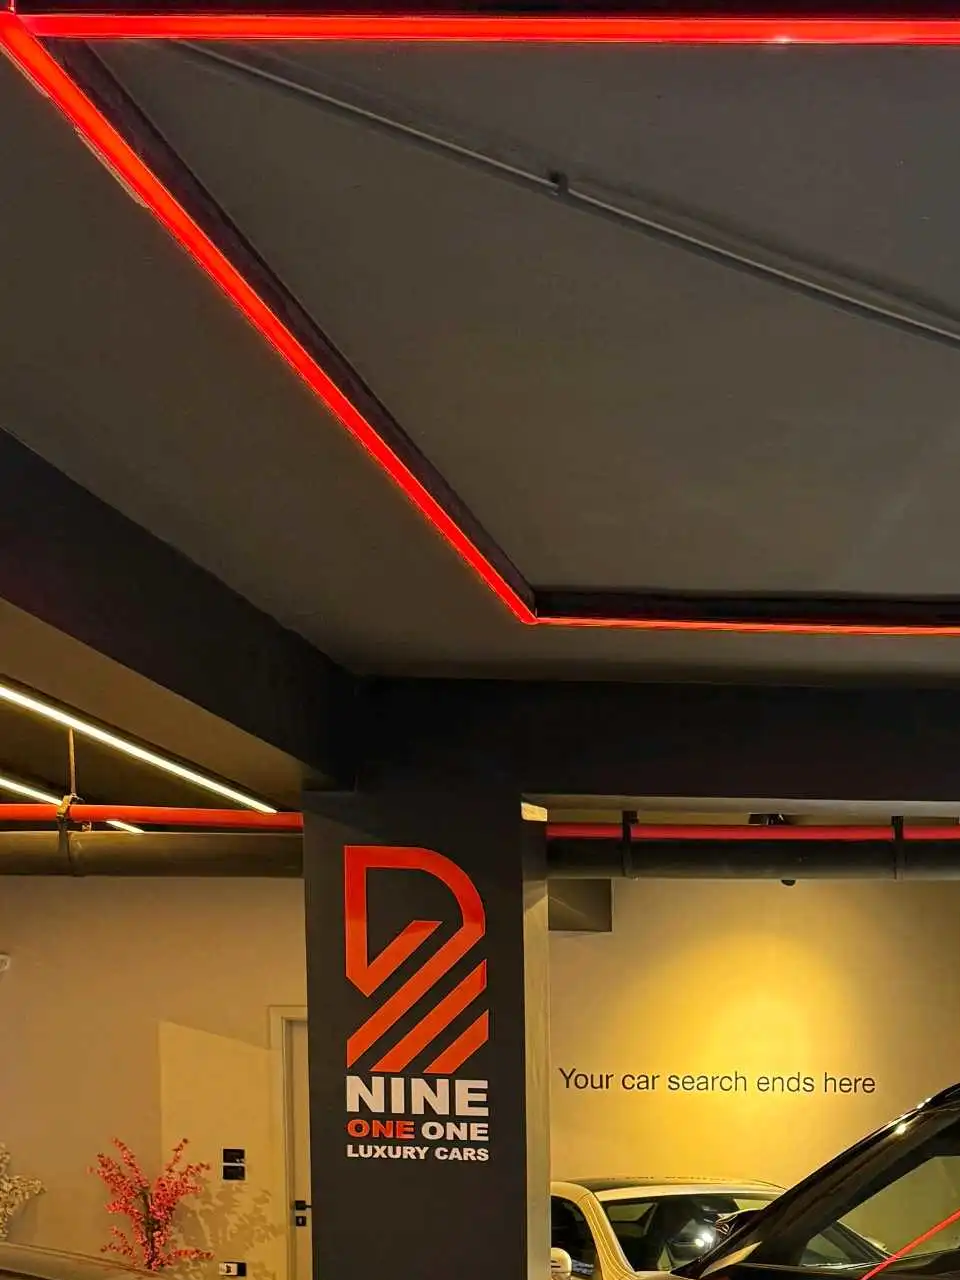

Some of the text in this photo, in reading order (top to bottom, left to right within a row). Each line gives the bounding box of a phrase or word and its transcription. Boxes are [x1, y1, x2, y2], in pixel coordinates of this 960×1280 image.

[558, 1067, 876, 1094] Your car search ends here
[346, 1075, 489, 1117] NINE
[347, 1119, 489, 1141] ONE ONE
[346, 1144, 489, 1162] LUXURY CARS
